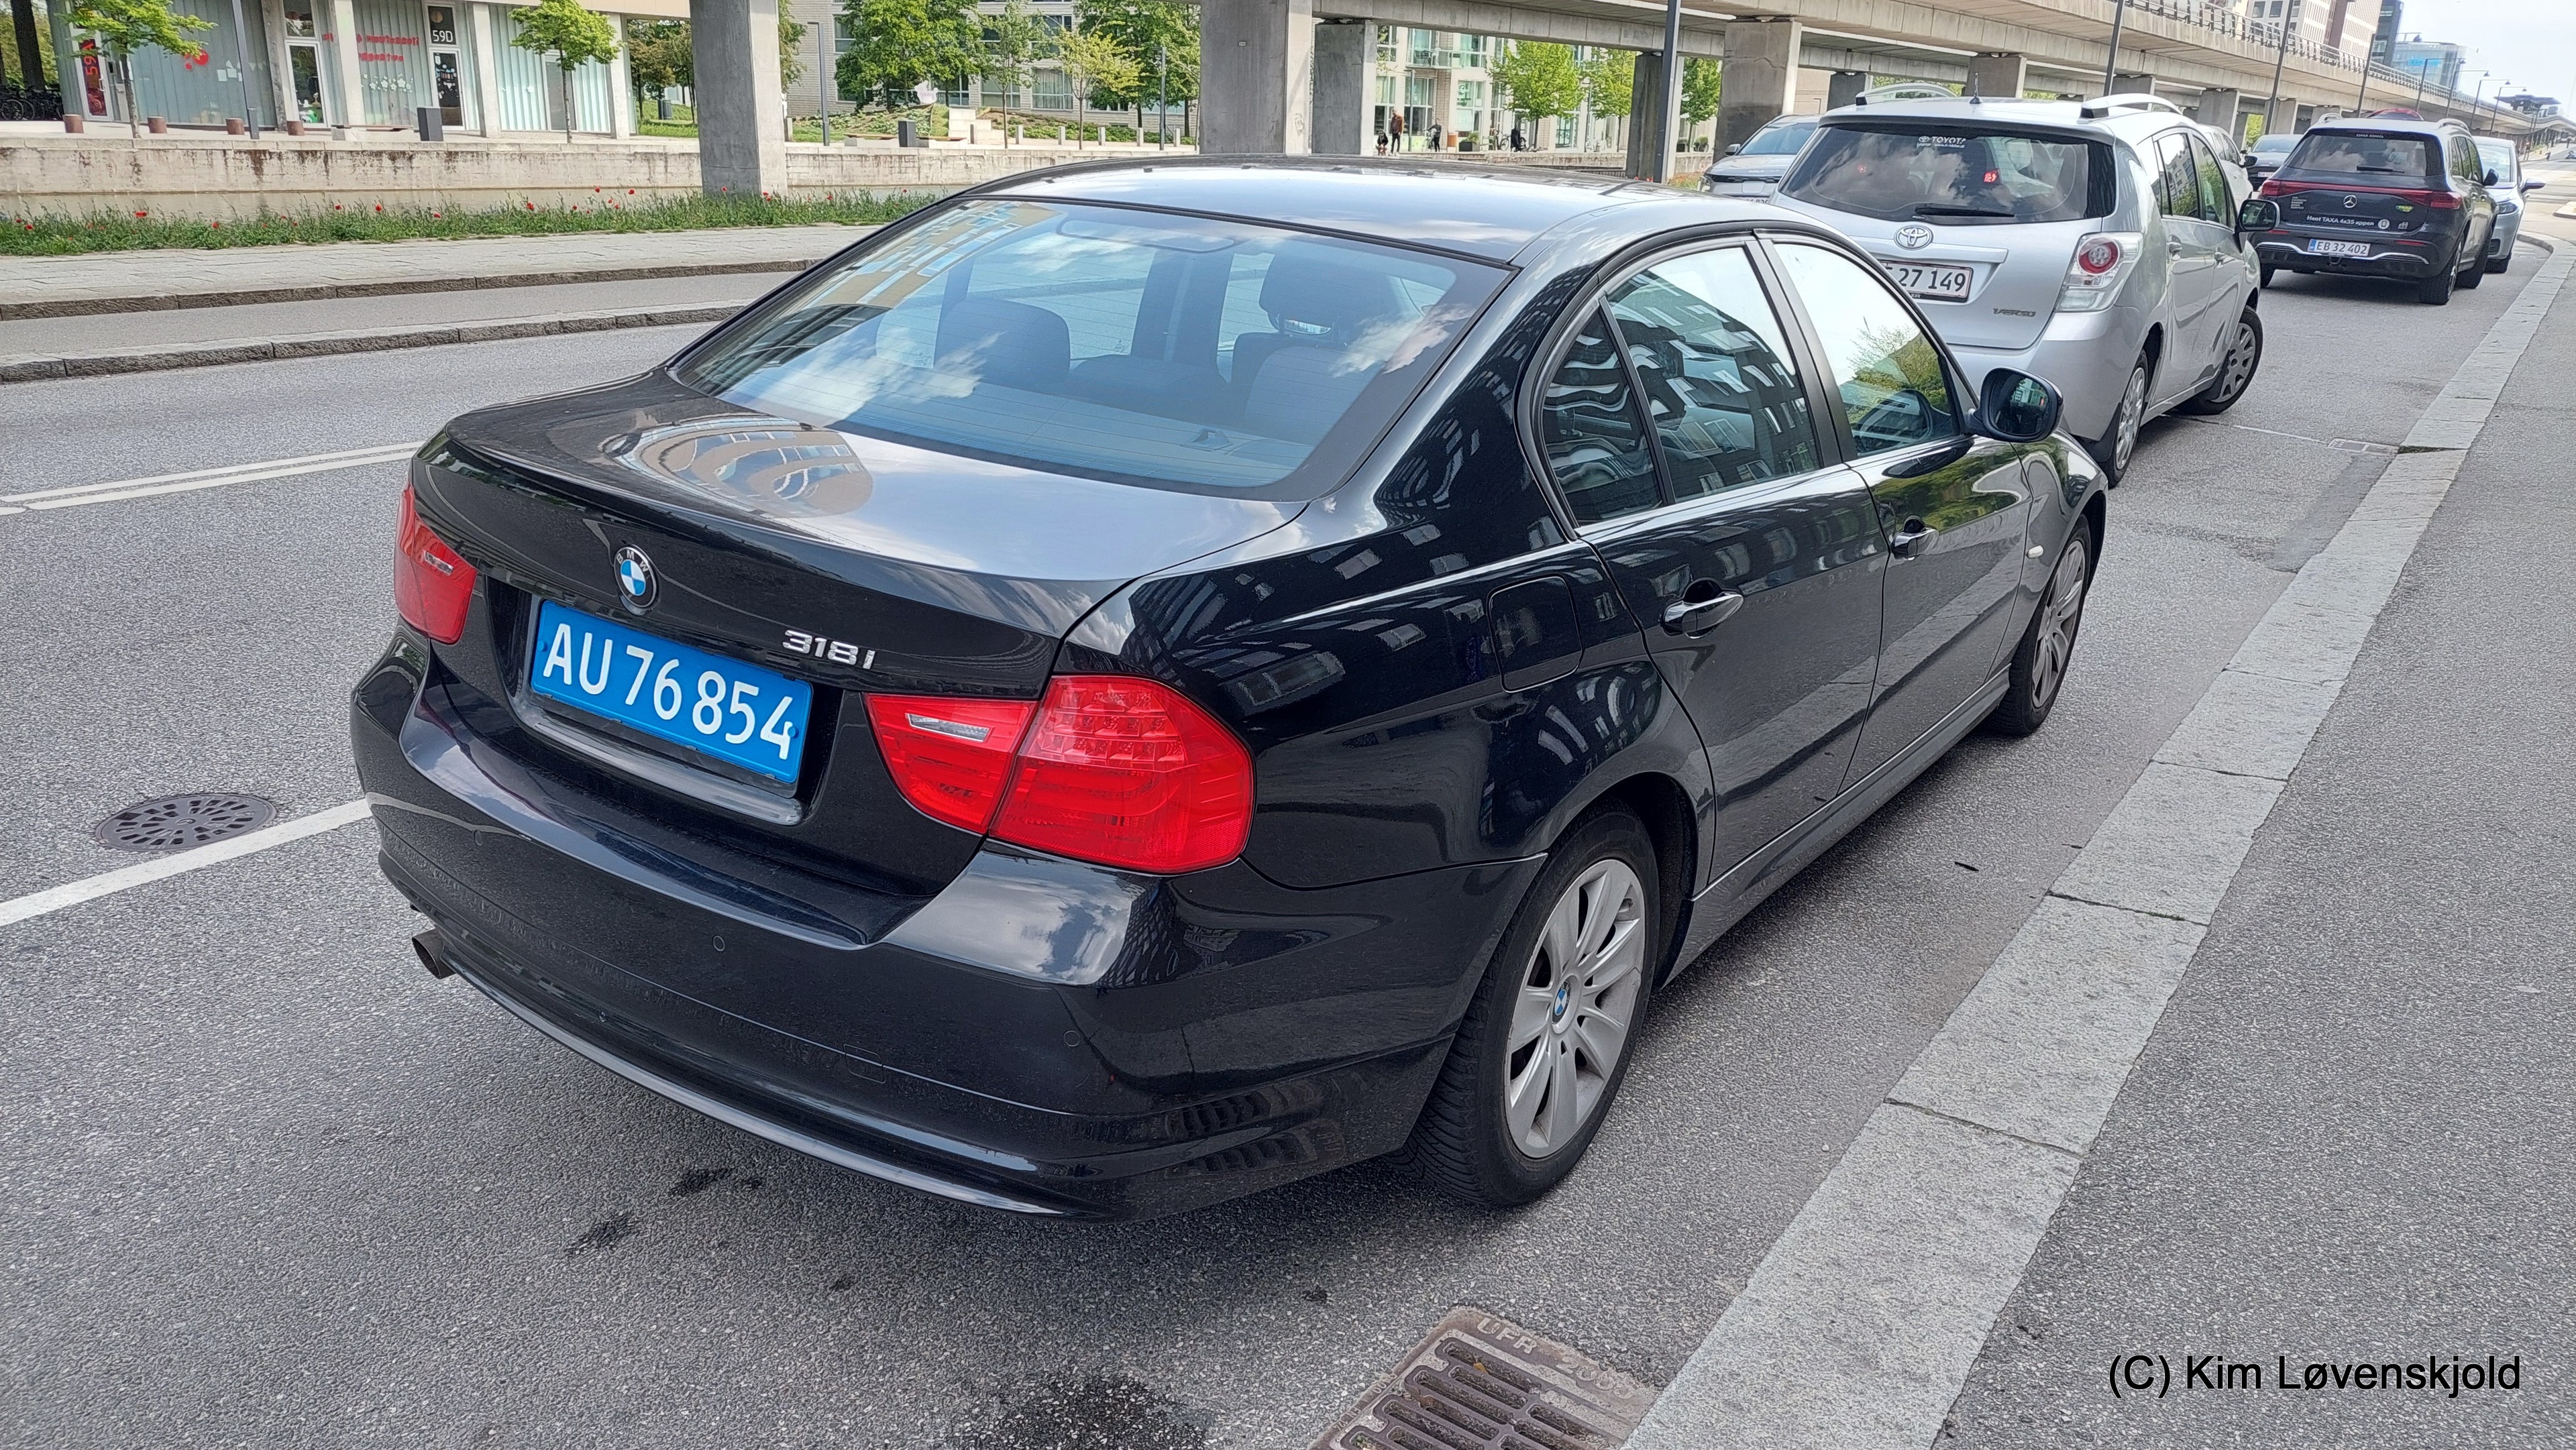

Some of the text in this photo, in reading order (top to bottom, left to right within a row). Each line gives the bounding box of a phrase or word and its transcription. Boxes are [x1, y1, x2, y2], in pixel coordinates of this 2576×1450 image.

[432, 30, 453, 42] 59D
[2316, 241, 2367, 254] EB 32 402
[1899, 268, 1966, 292] 27 149
[1992, 308, 2036, 317] VERSO
[616, 549, 649, 573] BMW
[543, 623, 794, 760] AU 76 854
